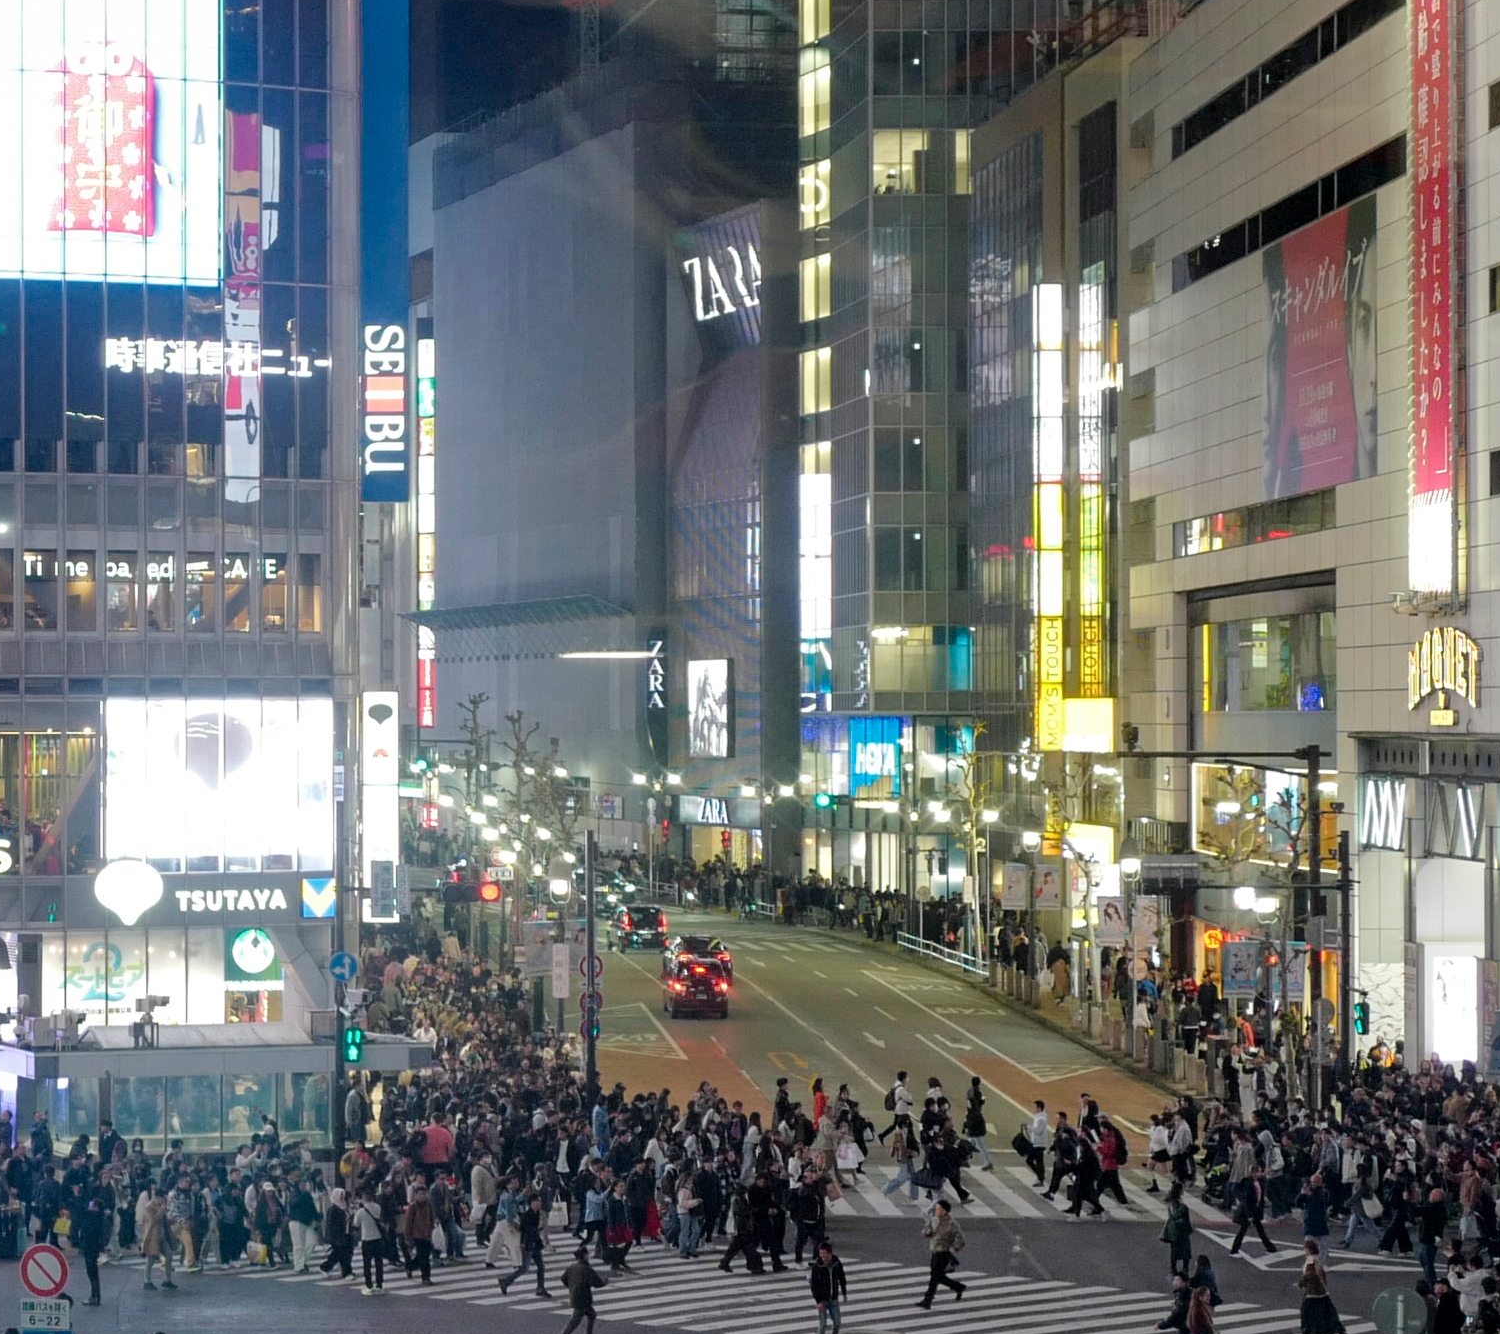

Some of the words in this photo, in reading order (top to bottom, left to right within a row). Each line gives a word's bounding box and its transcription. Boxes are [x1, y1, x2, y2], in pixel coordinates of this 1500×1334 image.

[363, 324, 406, 476] SEIBU
[1046, 617, 1059, 680] TOUCH
[647, 640, 666, 710] ZARA
[697, 798, 730, 825] ZARA
[175, 888, 288, 913] TSUTAYA
[27, 1313, 62, 1327] 6-22
